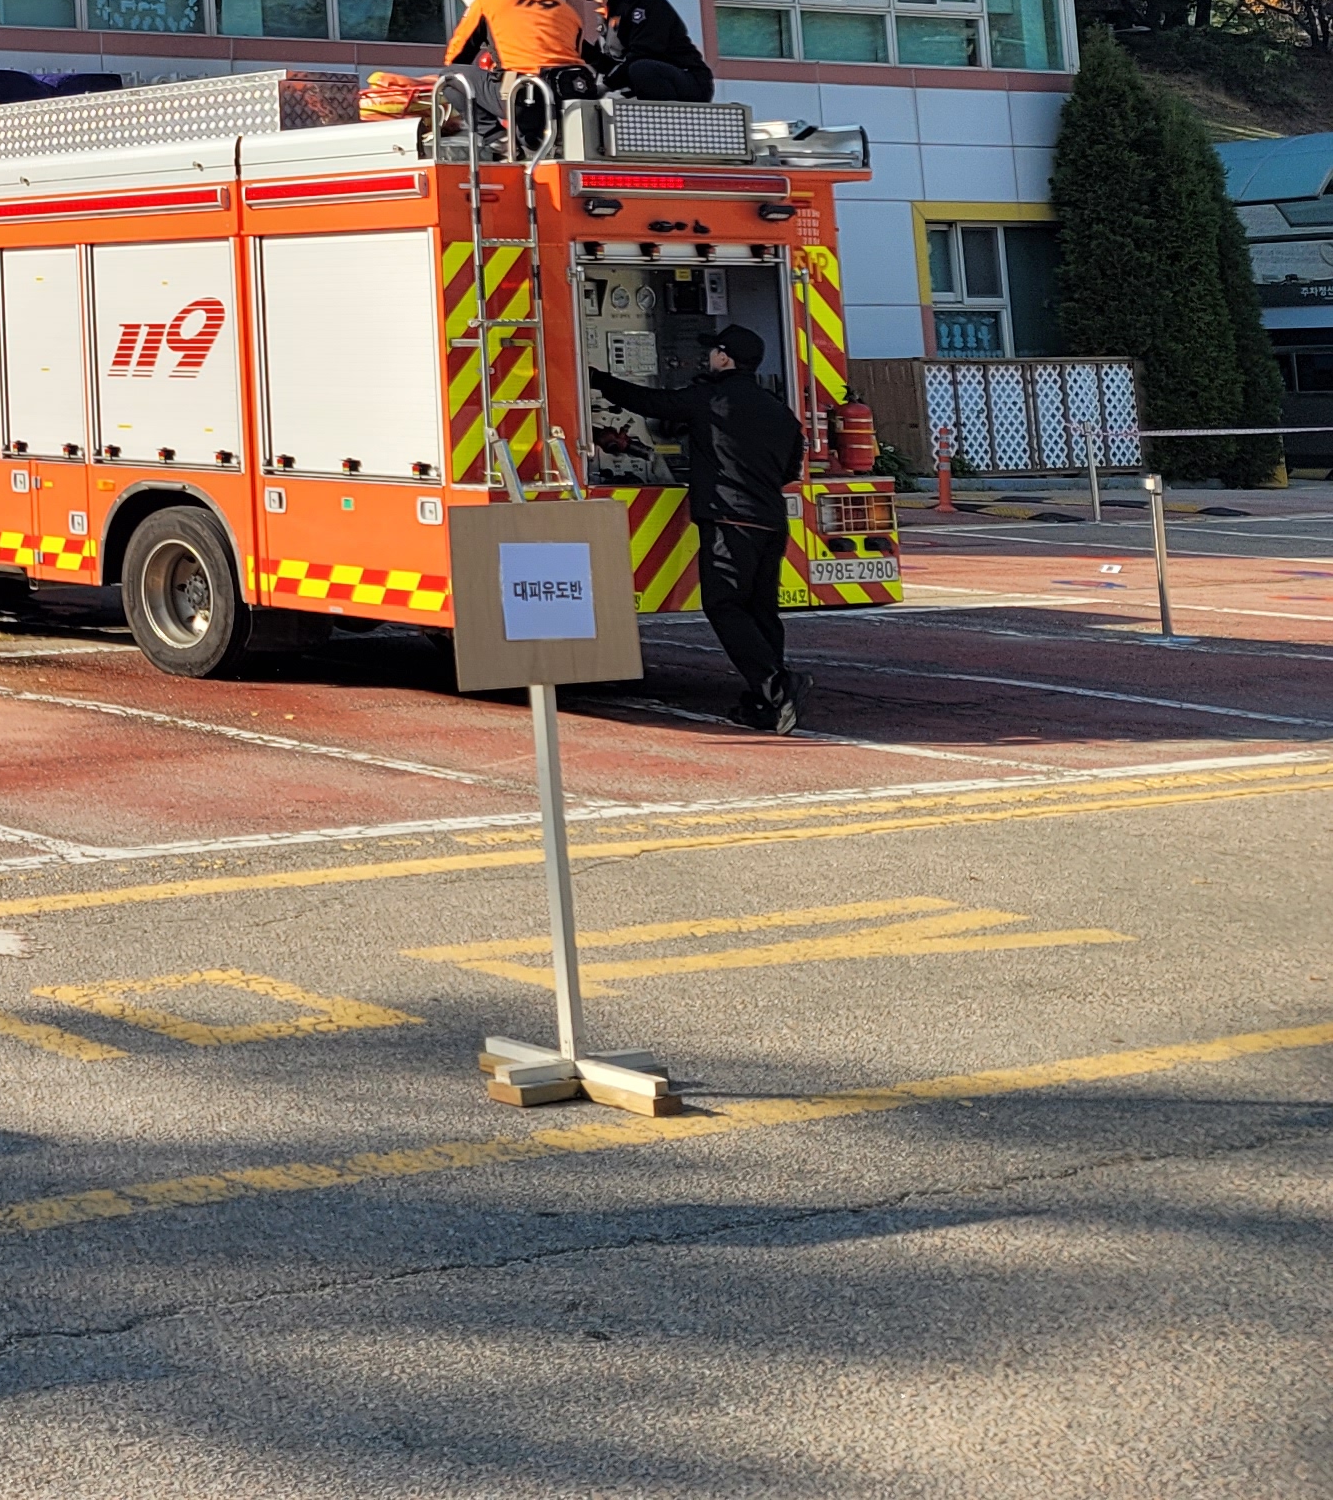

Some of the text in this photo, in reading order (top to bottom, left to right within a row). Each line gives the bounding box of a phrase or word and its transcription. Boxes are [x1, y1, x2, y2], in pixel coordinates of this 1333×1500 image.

[107, 296, 226, 379] 119
[816, 560, 893, 581] 998도 2980
[513, 580, 583, 602] 대피유도반
